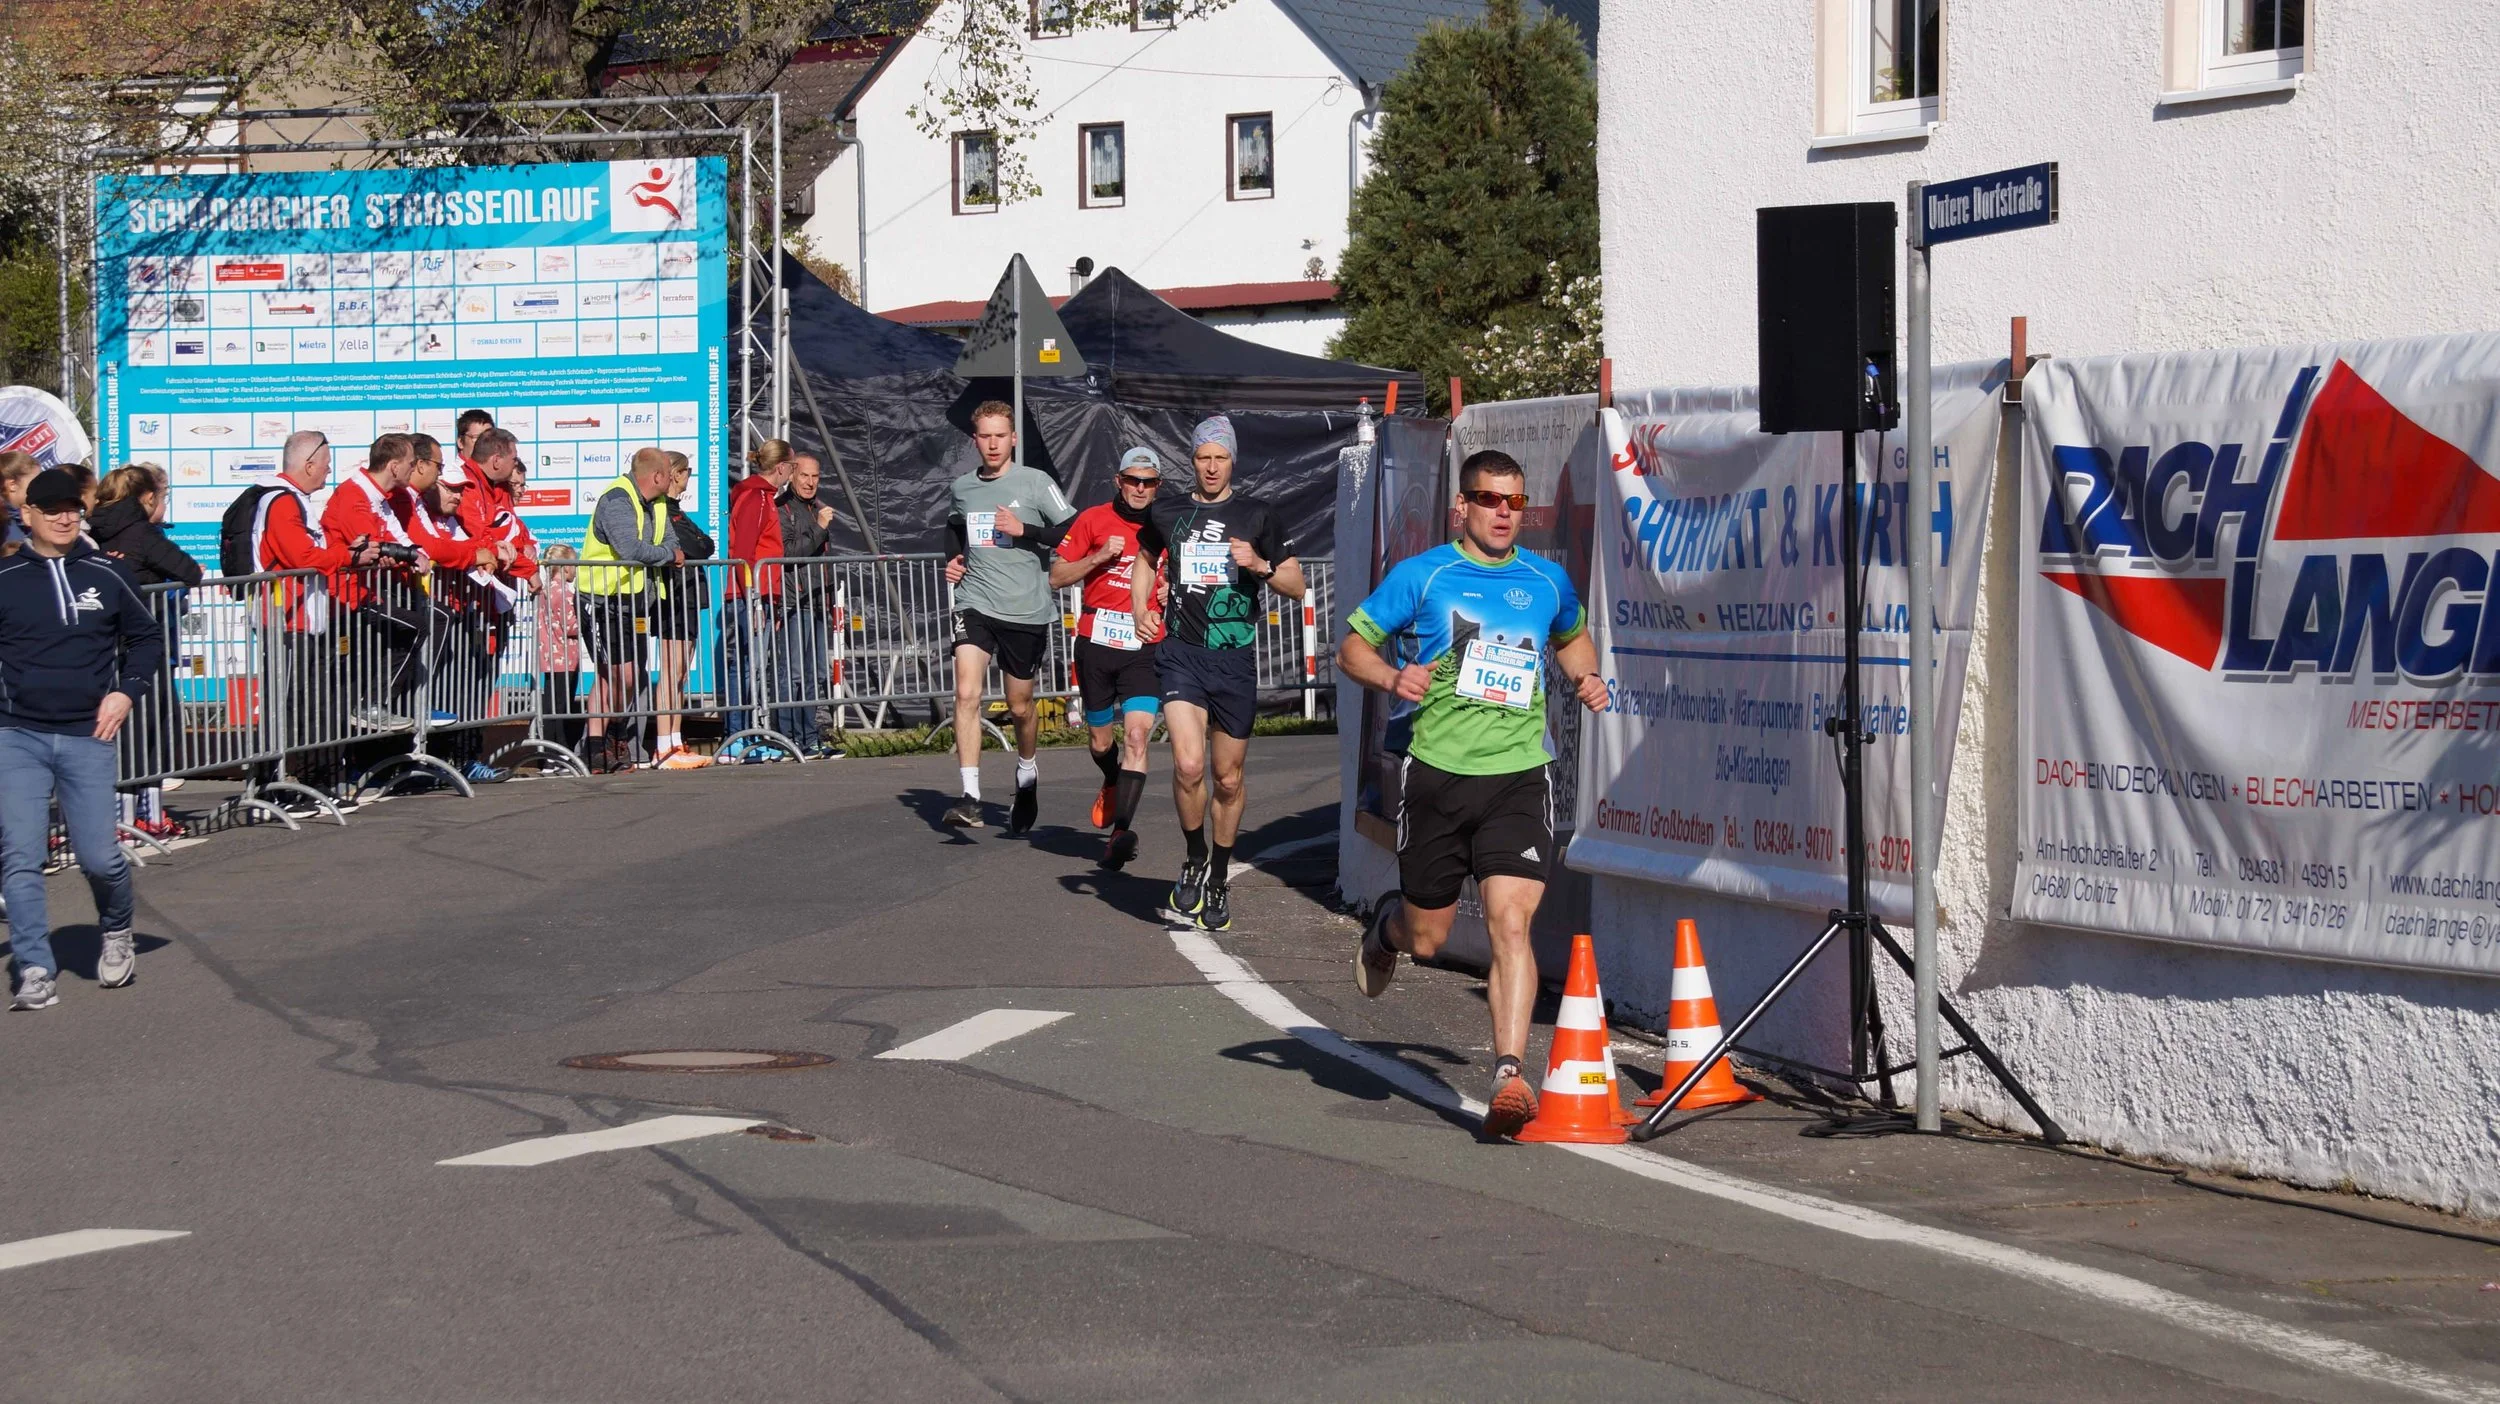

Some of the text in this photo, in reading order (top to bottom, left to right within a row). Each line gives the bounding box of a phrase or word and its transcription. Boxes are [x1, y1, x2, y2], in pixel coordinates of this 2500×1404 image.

[366, 186, 600, 229] STRASSENLAUF
[1928, 176, 2043, 230] Untere Dorfstraße
[662, 293, 694, 302] terraform
[299, 341, 327, 350] Mietra
[339, 339, 369, 352] Xella
[623, 414, 655, 424] B.B.F.
[583, 454, 611, 463] Mietra
[2039, 366, 2321, 562] DACH
[1780, 484, 1799, 568] &
[1191, 562, 1228, 574] 1645
[1103, 627, 1132, 640] 1614
[1615, 600, 1815, 633] SANITÄR HEIZUNG
[1475, 668, 1522, 693] 1646
[1671, 684, 1727, 725] Photovoltaik
[2036, 758, 2227, 802] DACHEINDECKUNGEN
[2246, 776, 2433, 813] BLECHARBEITEN
[1597, 798, 1642, 836] Grimma
[1650, 806, 1714, 846] Großbothen
[1722, 815, 1744, 849] Tel.:
[1754, 818, 1795, 856] 034384
[1805, 826, 1832, 862] 9070
[2035, 837, 2158, 872] Am Hochbehälter 2
[2195, 851, 2348, 890] Tel. 034381 45915
[2031, 873, 2119, 905] 04680 Colditz
[2188, 890, 2233, 918] Mobil:
[2236, 895, 2273, 922] 0172
[2282, 900, 2348, 929] 3416126
